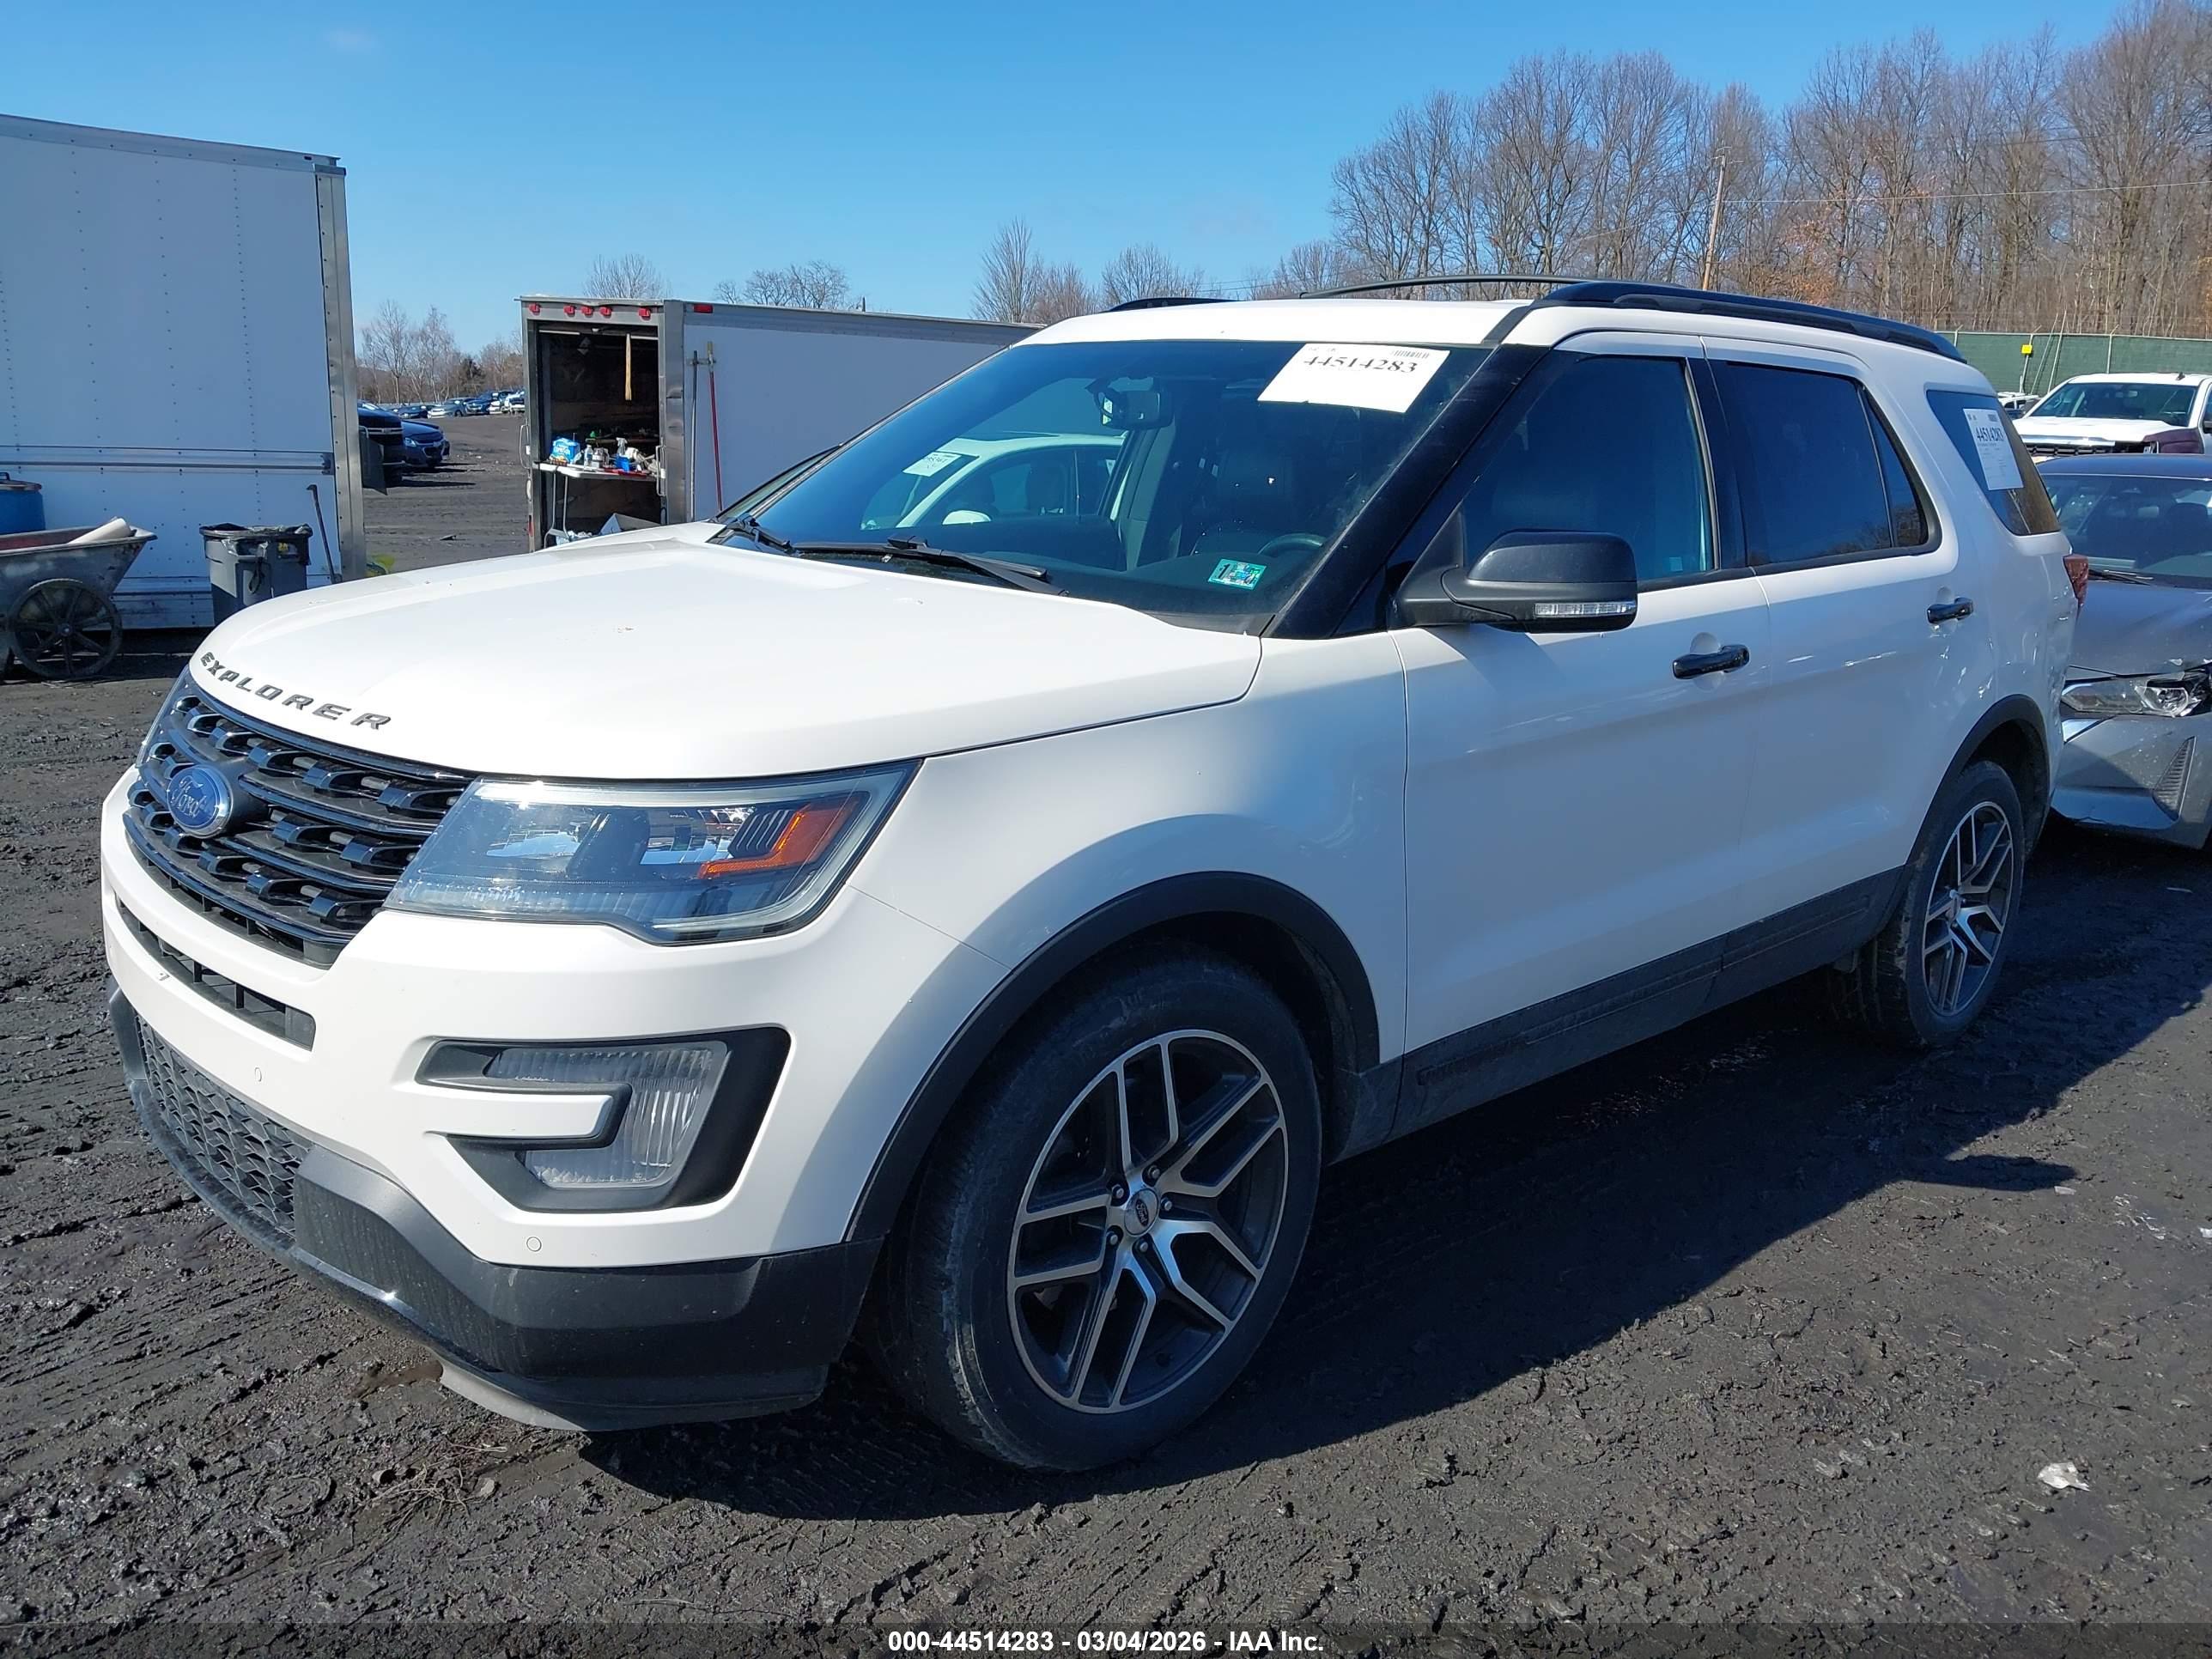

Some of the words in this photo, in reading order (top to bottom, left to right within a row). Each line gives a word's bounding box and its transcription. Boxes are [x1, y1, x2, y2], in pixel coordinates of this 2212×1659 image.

[1304, 356, 1418, 373] 44514283
[200, 652, 392, 730] EXPLORER
[171, 775, 207, 817] Ford
[1137, 1203, 1148, 1224] Ford
